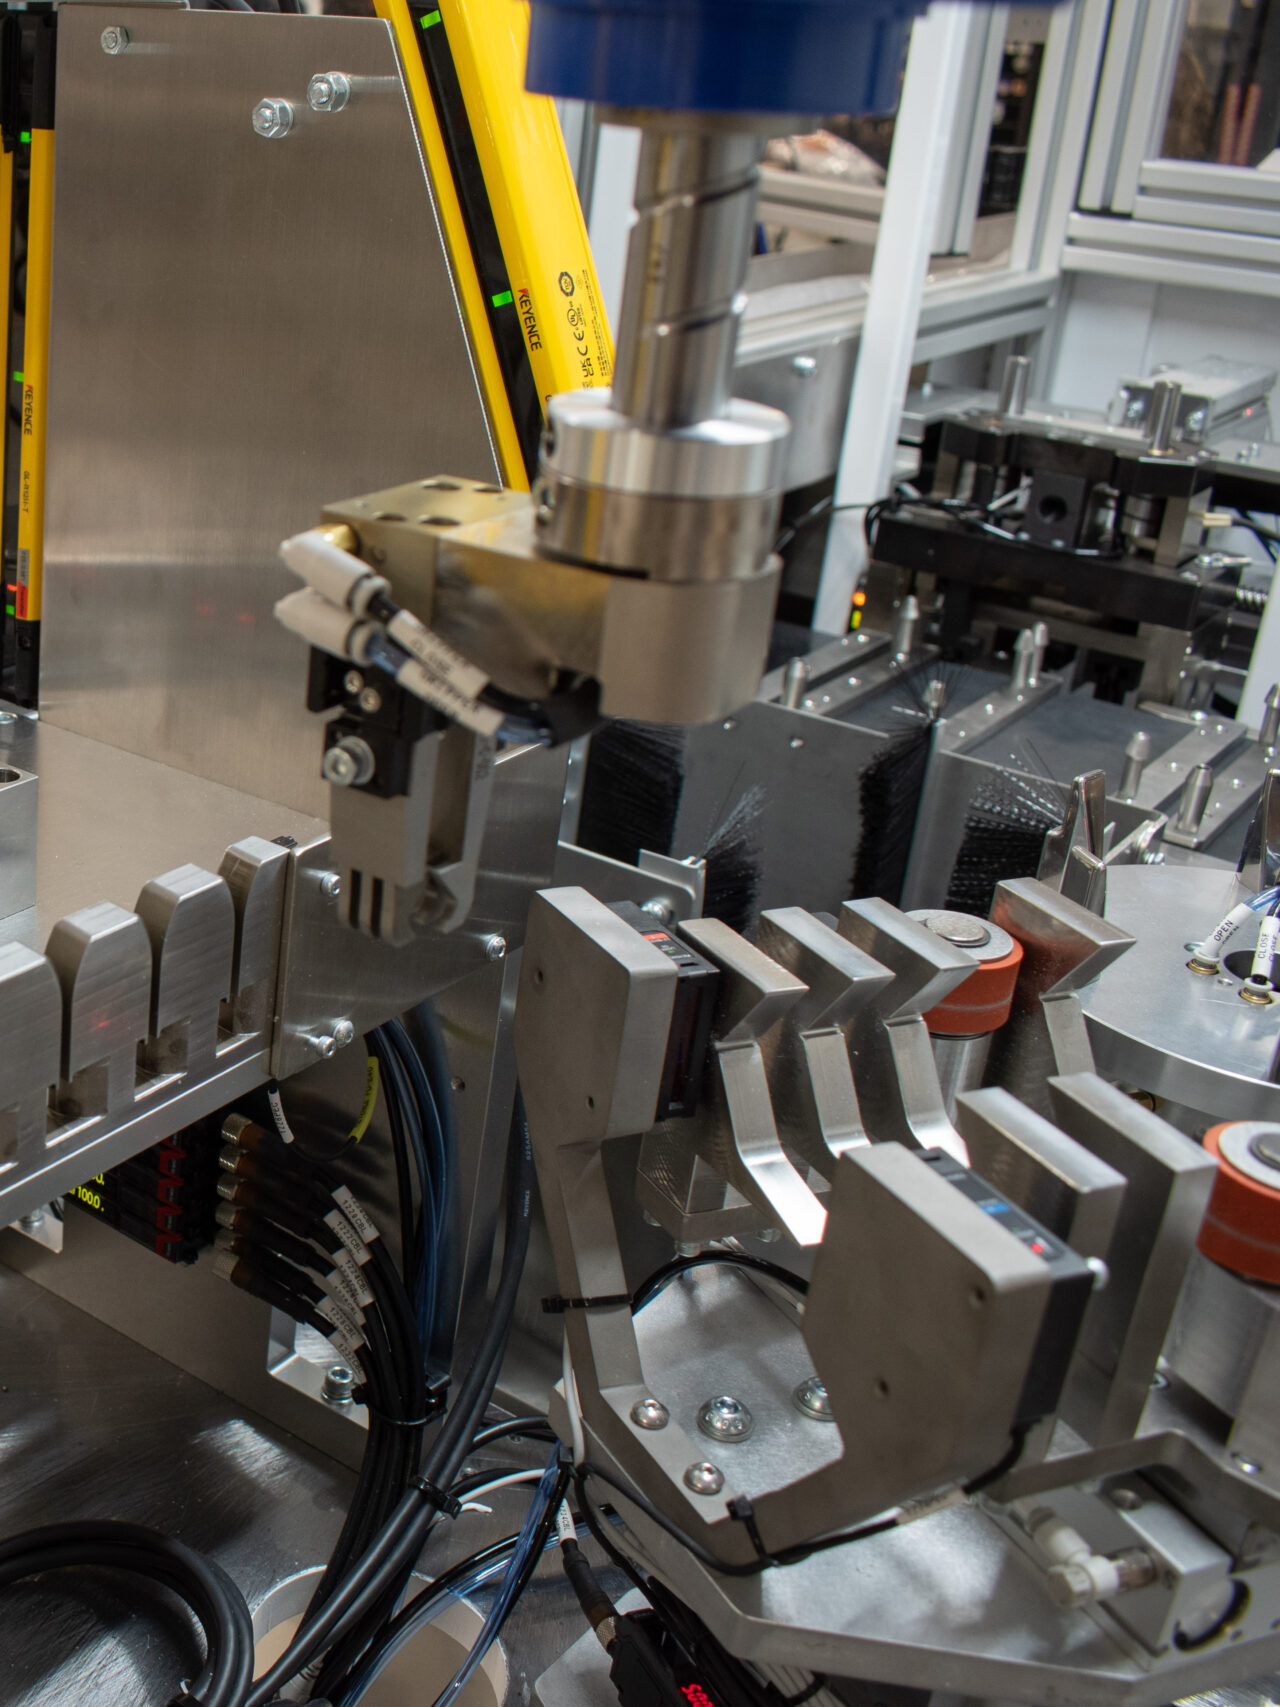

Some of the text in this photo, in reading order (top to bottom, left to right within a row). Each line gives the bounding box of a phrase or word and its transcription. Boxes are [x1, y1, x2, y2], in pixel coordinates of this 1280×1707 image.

[518, 288, 542, 351] KEYENCE
[23, 384, 34, 435] KEYENCE
[1214, 920, 1233, 941] OPEN
[1258, 933, 1269, 958] CLOSE
